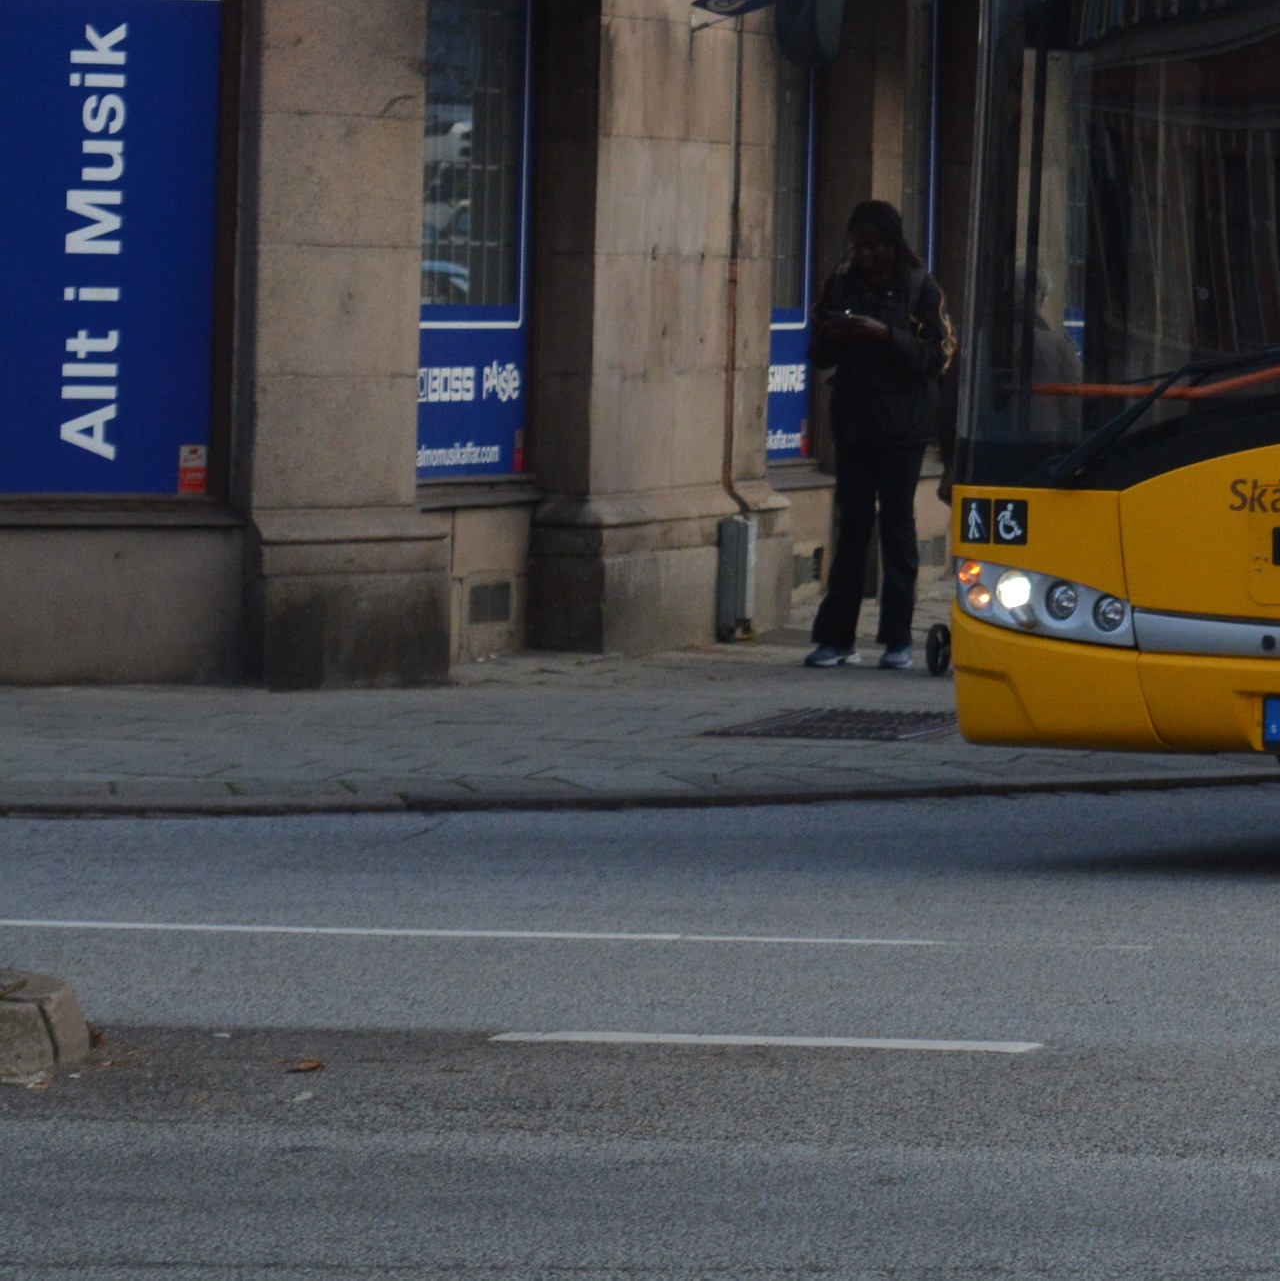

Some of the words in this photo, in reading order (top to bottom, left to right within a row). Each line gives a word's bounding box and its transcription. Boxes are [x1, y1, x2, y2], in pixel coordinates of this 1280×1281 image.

[65, 22, 128, 255] Musik
[64, 286, 120, 302] i
[60, 330, 119, 462] Allt
[427, 366, 476, 403] BOSS
[767, 364, 806, 393] SHURE
